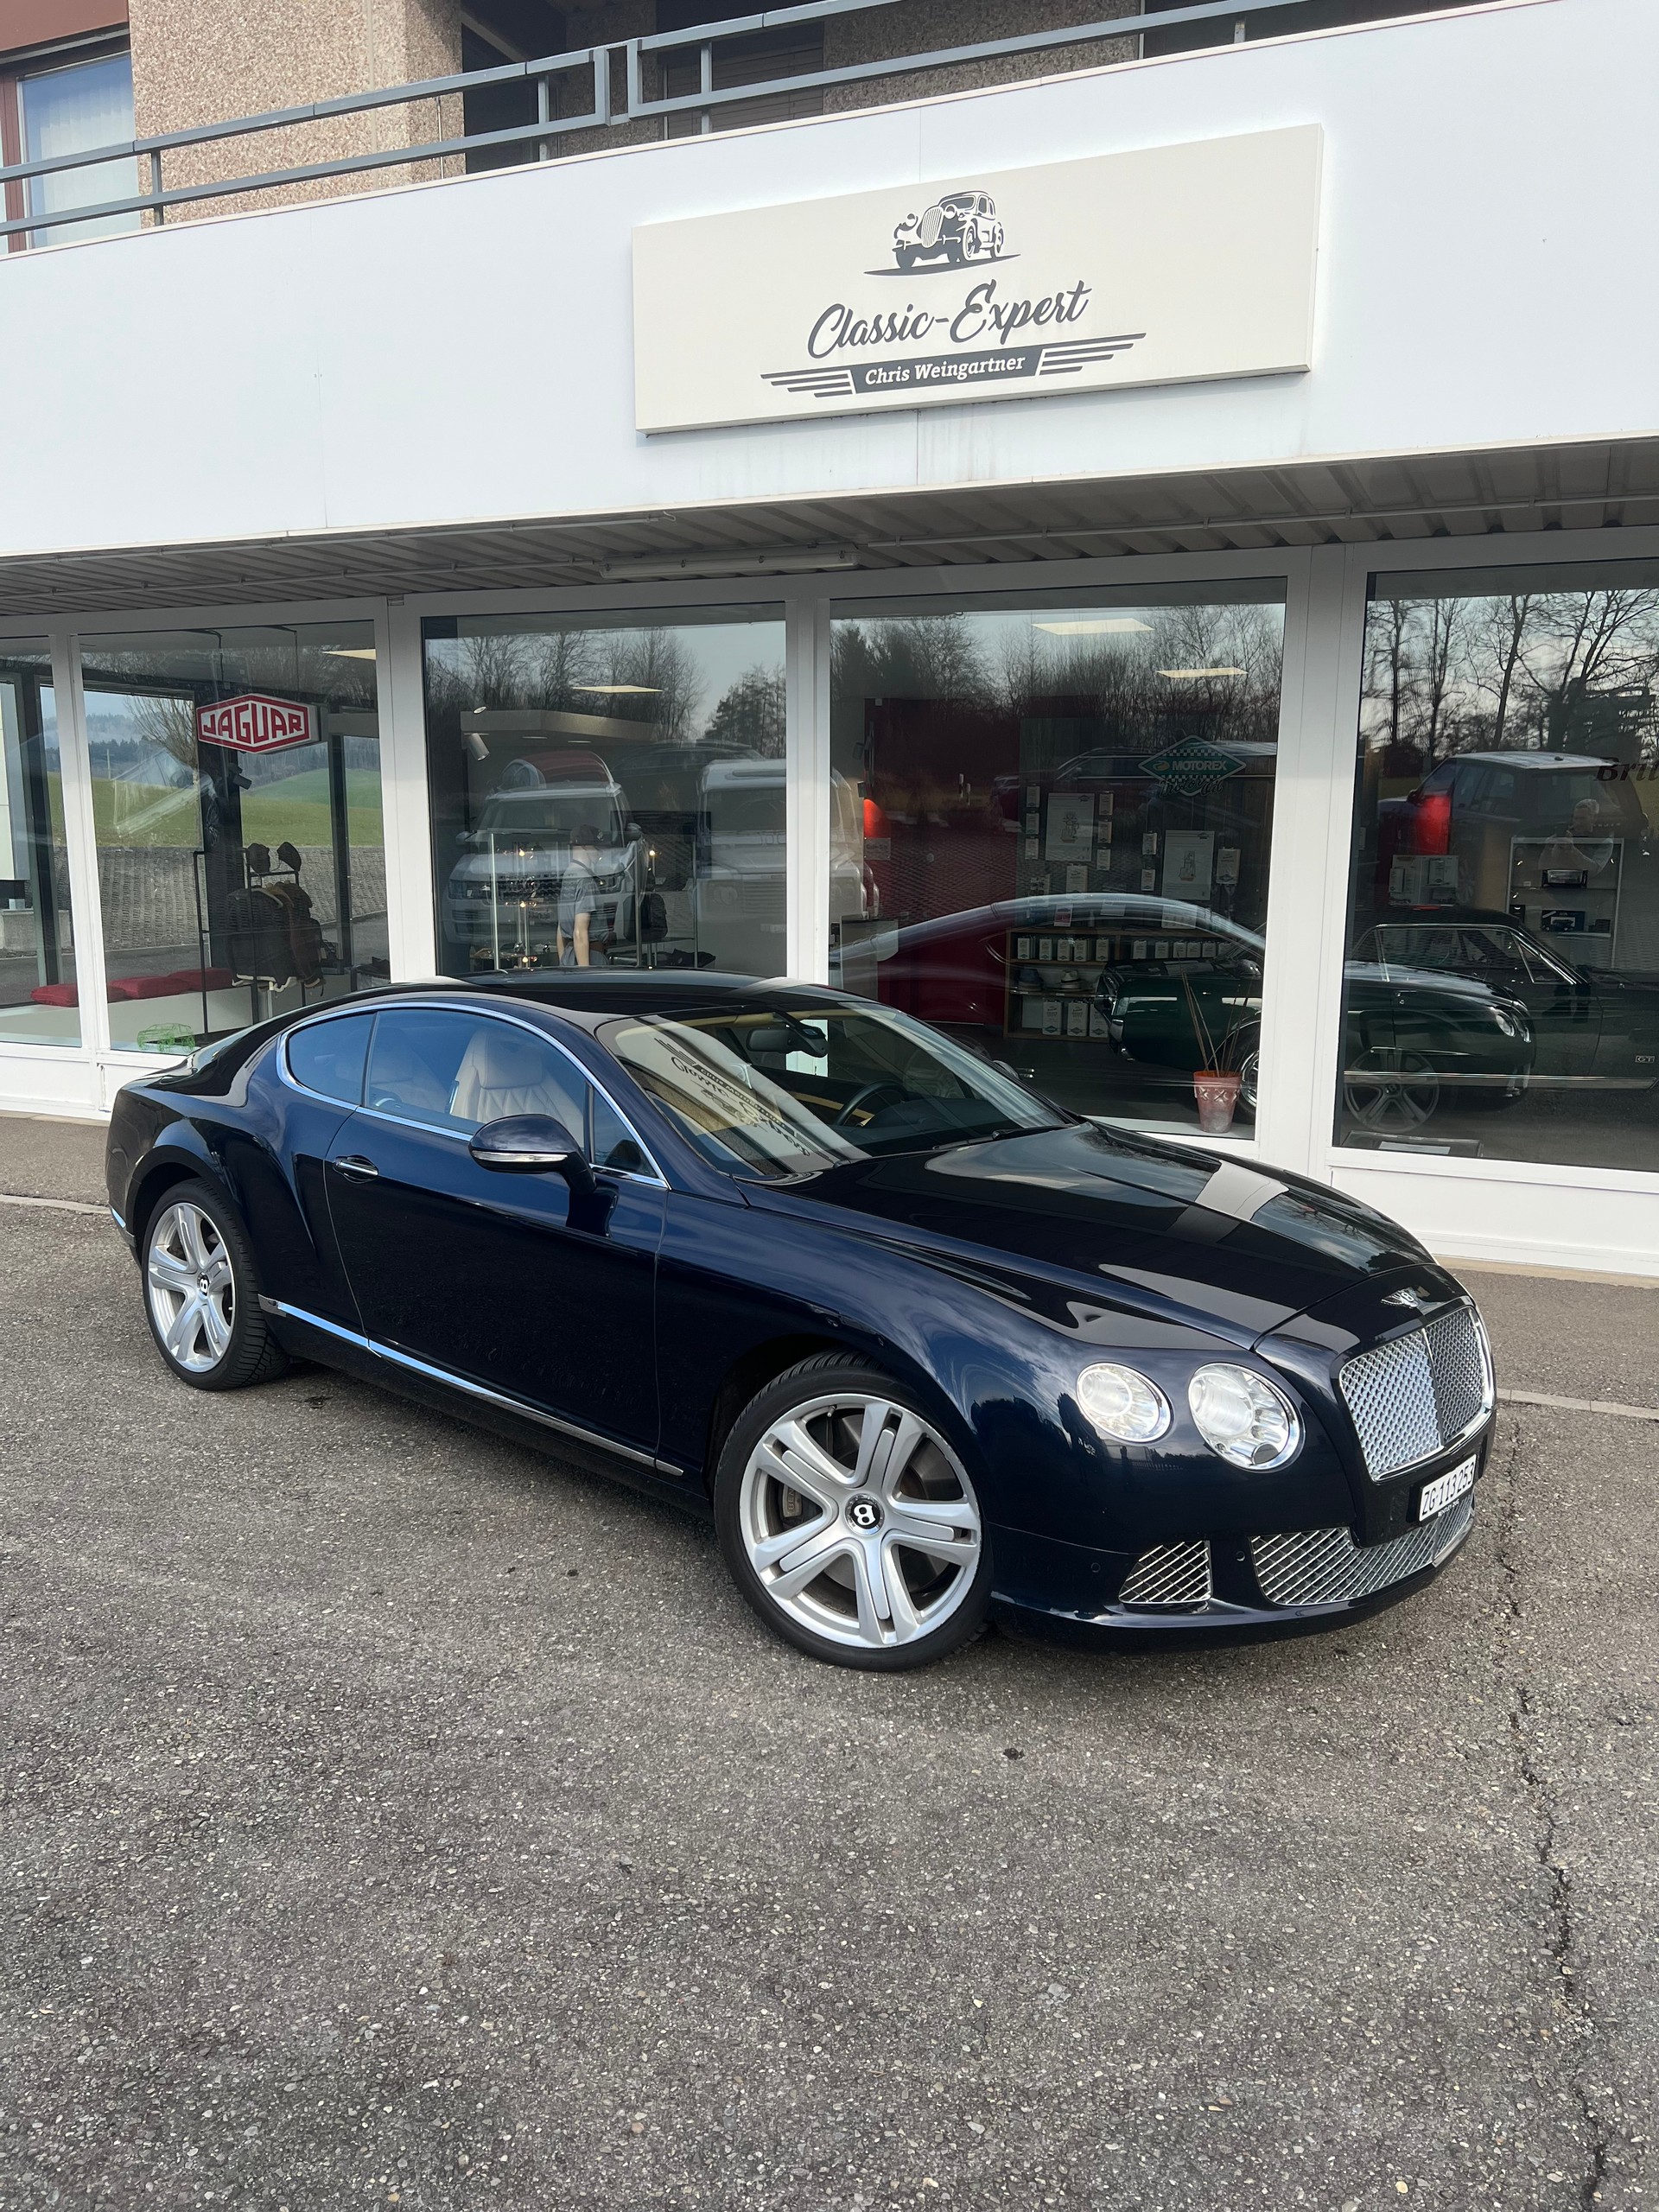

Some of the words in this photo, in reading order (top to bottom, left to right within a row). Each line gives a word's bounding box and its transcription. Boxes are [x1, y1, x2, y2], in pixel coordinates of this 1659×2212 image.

[807, 279, 1092, 359] Classic-Expert
[865, 365, 911, 386] Chris
[914, 354, 1026, 381] Weingartner
[204, 703, 302, 744] JAGUAR
[1173, 760, 1227, 771] MOTOREX
